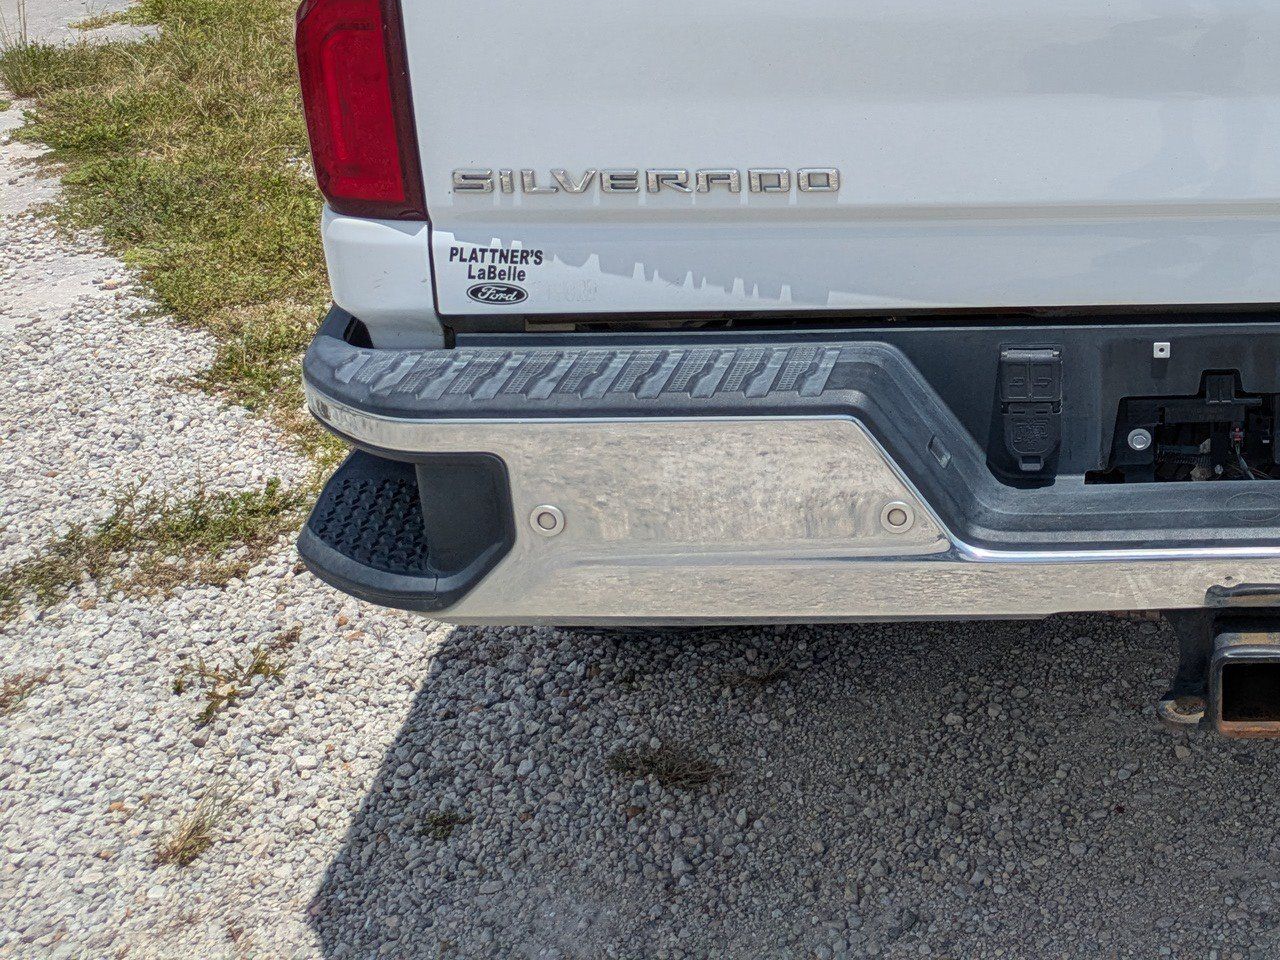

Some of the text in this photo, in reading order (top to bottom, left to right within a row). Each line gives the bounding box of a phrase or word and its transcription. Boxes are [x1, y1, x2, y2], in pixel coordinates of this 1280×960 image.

[452, 167, 841, 193] SILVERADO
[449, 246, 543, 266] PLATTNER'S
[467, 264, 526, 281] LaBelle
[476, 284, 519, 302] Ford
